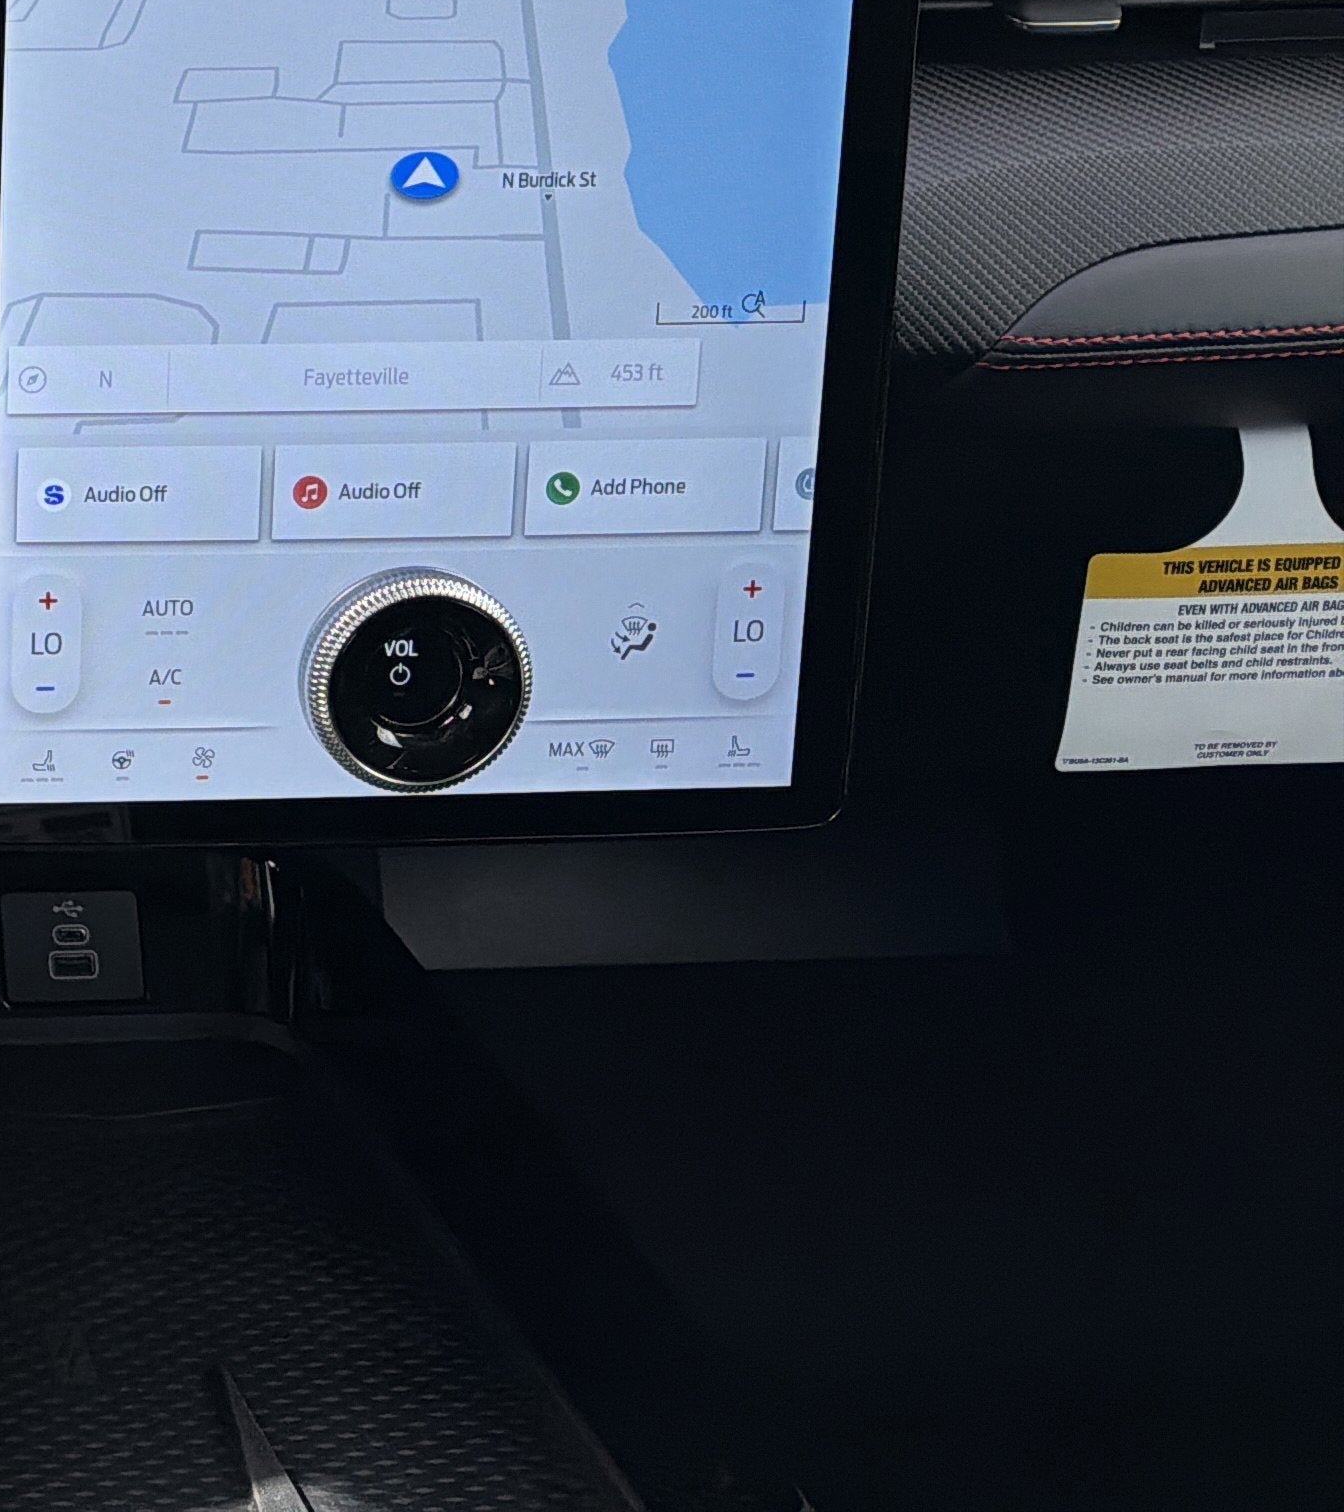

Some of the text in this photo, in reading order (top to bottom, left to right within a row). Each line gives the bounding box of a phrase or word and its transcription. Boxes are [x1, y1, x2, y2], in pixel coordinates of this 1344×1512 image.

[501, 171, 597, 188] N Burdick St
[691, 304, 733, 319] 200 ft
[99, 370, 113, 388] N
[303, 367, 410, 390] Fayetteville
[611, 363, 664, 381] 453 ft
[83, 485, 168, 503] Audio Off
[338, 481, 423, 500] Audio Off
[590, 478, 686, 495] Add Phone
[1163, 556, 1341, 575] THIS VEHICLE IS EQUIPPED
[1198, 576, 1339, 593] ADVANCED AIR BAGS
[141, 599, 194, 617] AUTO
[1177, 604, 1207, 616] EVEN
[1210, 603, 1239, 615] WITH
[1240, 601, 1299, 614] ADVANCED
[1300, 600, 1320, 612] AIR
[732, 619, 765, 644] LO
[1100, 621, 1151, 632] Children
[1153, 623, 1175, 631] can
[1177, 620, 1192, 631] be
[1195, 619, 1226, 630] killed
[1228, 621, 1241, 629] or
[1243, 617, 1296, 629] seriously
[1298, 616, 1339, 629] injured
[30, 631, 63, 656] LO
[1099, 635, 1121, 645] The
[1123, 634, 1152, 645] back
[1154, 634, 1180, 644] seat
[1182, 634, 1193, 643] is
[1195, 633, 1214, 643] the
[1216, 632, 1251, 643] safest
[1253, 631, 1284, 643] place
[1286, 630, 1304, 640] for
[384, 639, 419, 657] VOL
[1096, 648, 1131, 659] Never
[1133, 648, 1153, 660] put
[1165, 648, 1189, 657] rear
[1191, 646, 1227, 658] facing
[1229, 644, 1258, 655] child
[1260, 644, 1285, 654] seat
[1287, 643, 1298, 653] in
[1300, 642, 1319, 653] the
[1093, 656, 1333, 673] Always use seat belts and child restraints.
[148, 668, 182, 686] A/C
[1092, 667, 1344, 684] See owner's manual for more information ab
[548, 740, 584, 758] MAX
[1194, 743, 1206, 751] TO
